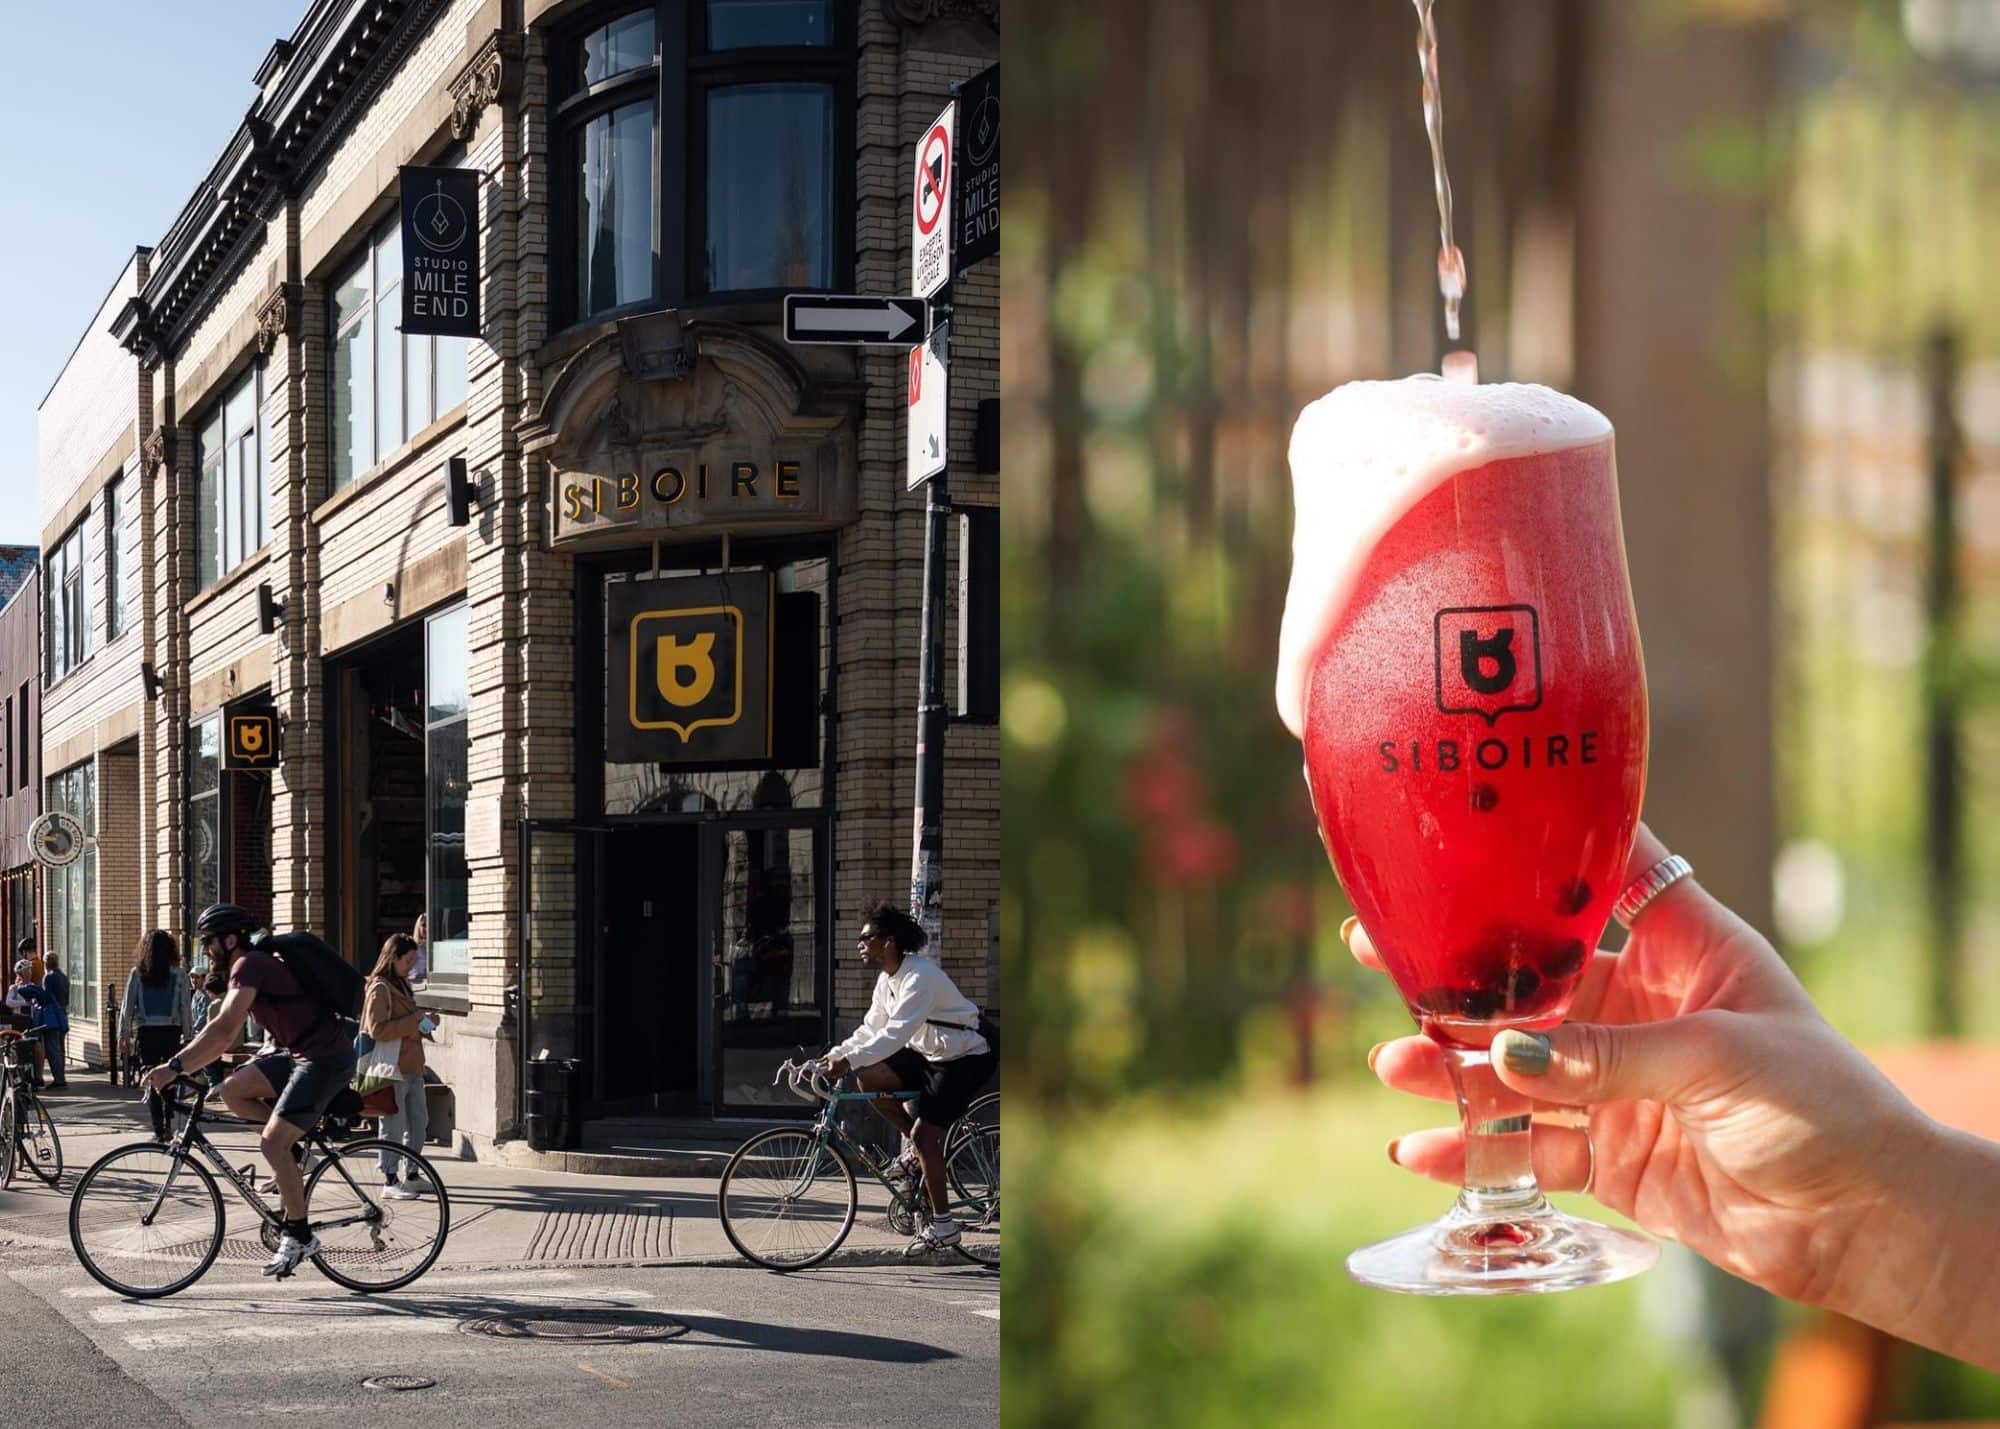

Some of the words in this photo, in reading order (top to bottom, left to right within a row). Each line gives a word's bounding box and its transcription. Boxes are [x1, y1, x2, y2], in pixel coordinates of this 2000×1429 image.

[965, 162, 999, 193] STUDIO
[964, 178, 999, 219] MILE
[964, 207, 999, 246] END
[414, 256, 468, 271] STUDIO
[917, 242, 944, 280] LIVRAISON
[920, 262, 940, 292] LOCALE
[414, 271, 469, 294] MILE
[413, 295, 468, 318] END
[563, 460, 800, 520] SIBOIRE
[1380, 731, 1599, 773] SIBOIRE
